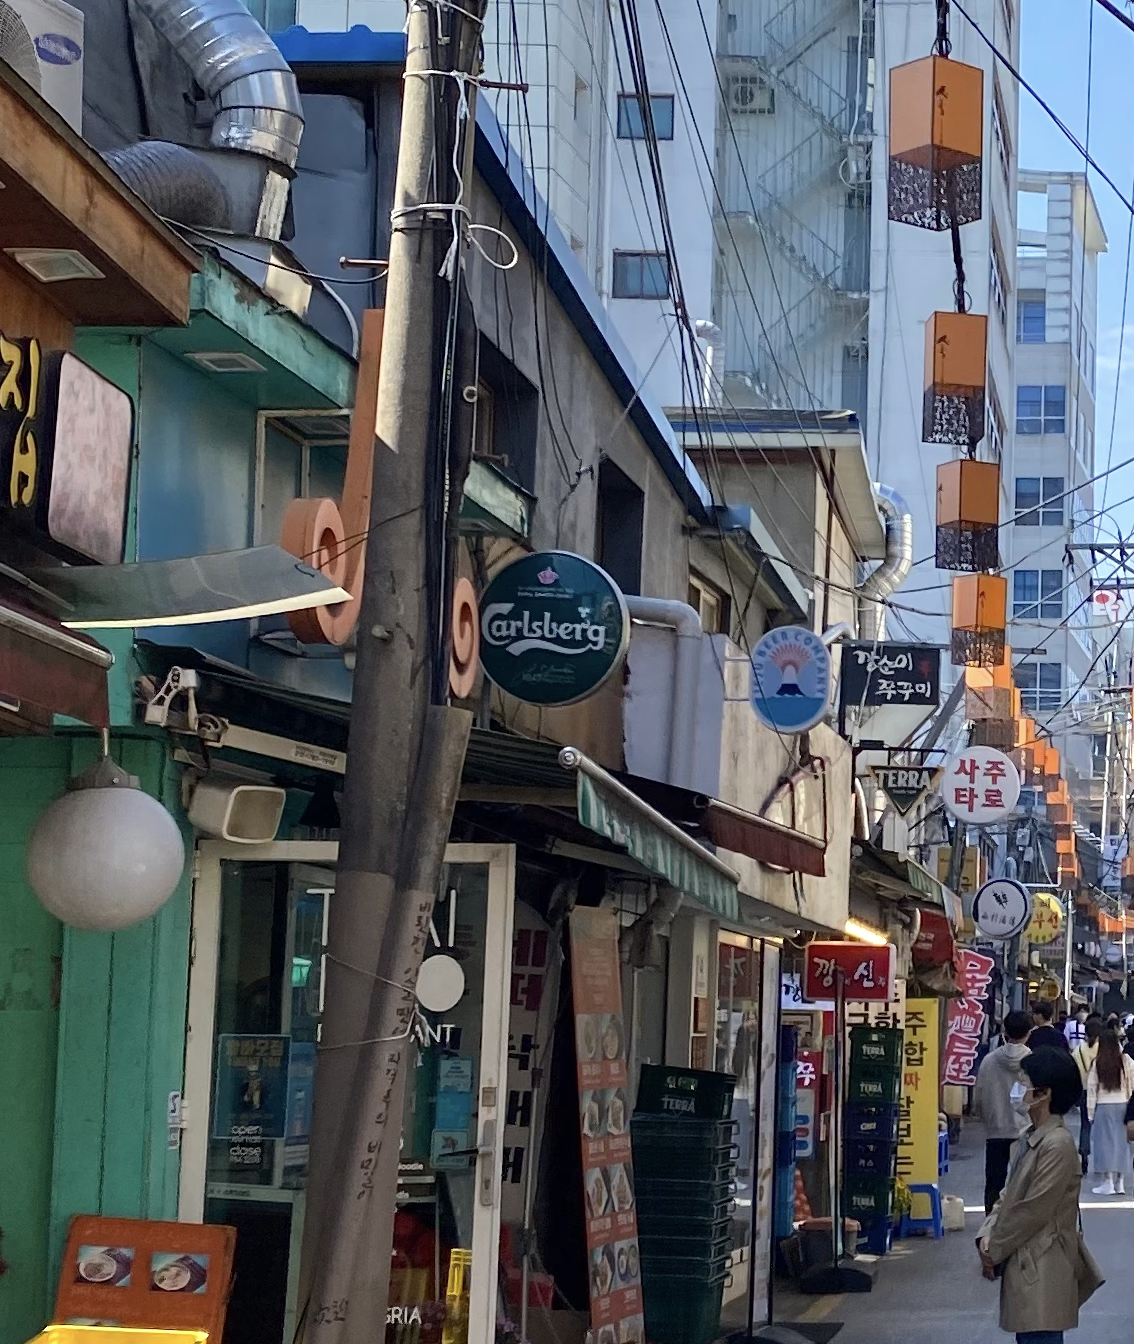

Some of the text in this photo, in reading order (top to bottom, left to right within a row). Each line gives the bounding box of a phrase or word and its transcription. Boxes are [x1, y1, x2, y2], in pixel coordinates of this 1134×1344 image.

[482, 603, 607, 650] Carlsberg
[760, 631, 788, 657] BEER
[794, 630, 827, 695] COMPANY
[875, 679, 931, 701] 쭈꾸미
[876, 769, 932, 790] TERRA
[953, 758, 1007, 785] 사주
[953, 786, 1007, 813] 타로
[862, 1044, 885, 1056] TERRA
[859, 1083, 883, 1095] TERRA
[660, 1097, 696, 1114] TERRA
[231, 1125, 262, 1135] open
[230, 1145, 262, 1157] close
[852, 1196, 875, 1208] TERRA
